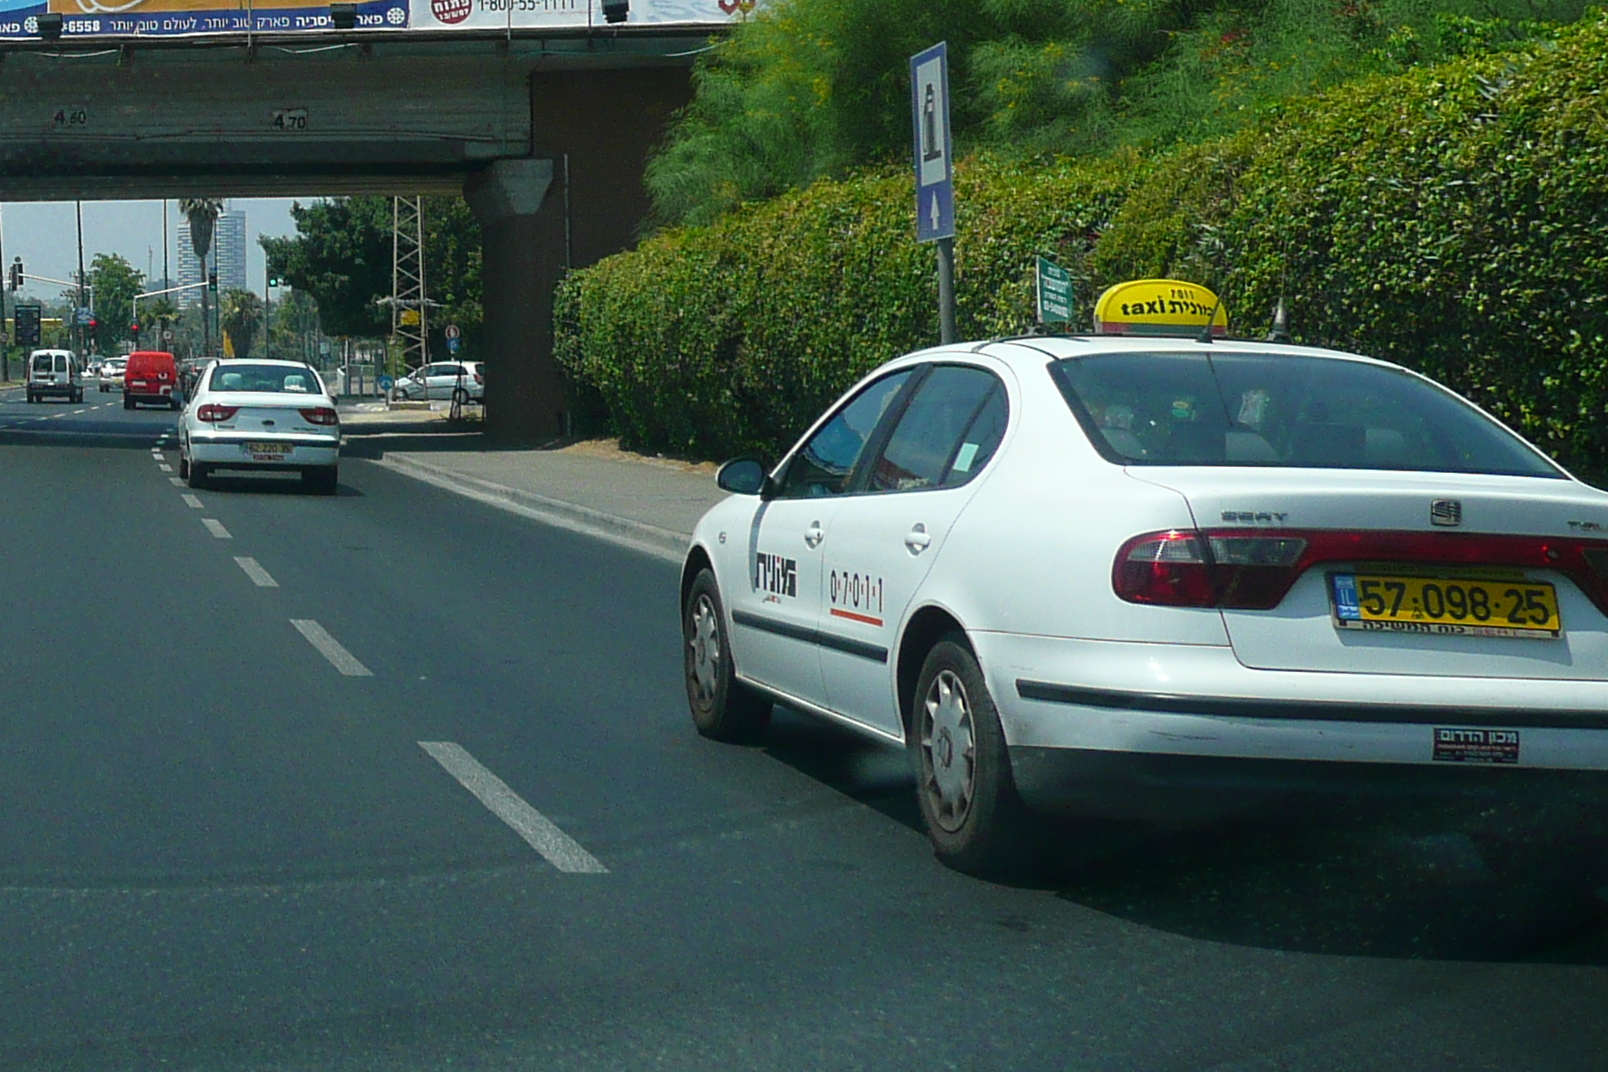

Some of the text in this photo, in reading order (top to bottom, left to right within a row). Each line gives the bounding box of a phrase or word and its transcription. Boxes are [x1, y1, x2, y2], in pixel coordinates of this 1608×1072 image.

[139, 21, 158, 30] טוב
[163, 17, 197, 30] לעולם
[257, 17, 290, 30] פארק
[295, 16, 333, 27] יסריה
[356, 15, 384, 25] פאר
[1121, 295, 1166, 316] taxi
[1488, 731, 1517, 744] מכון
